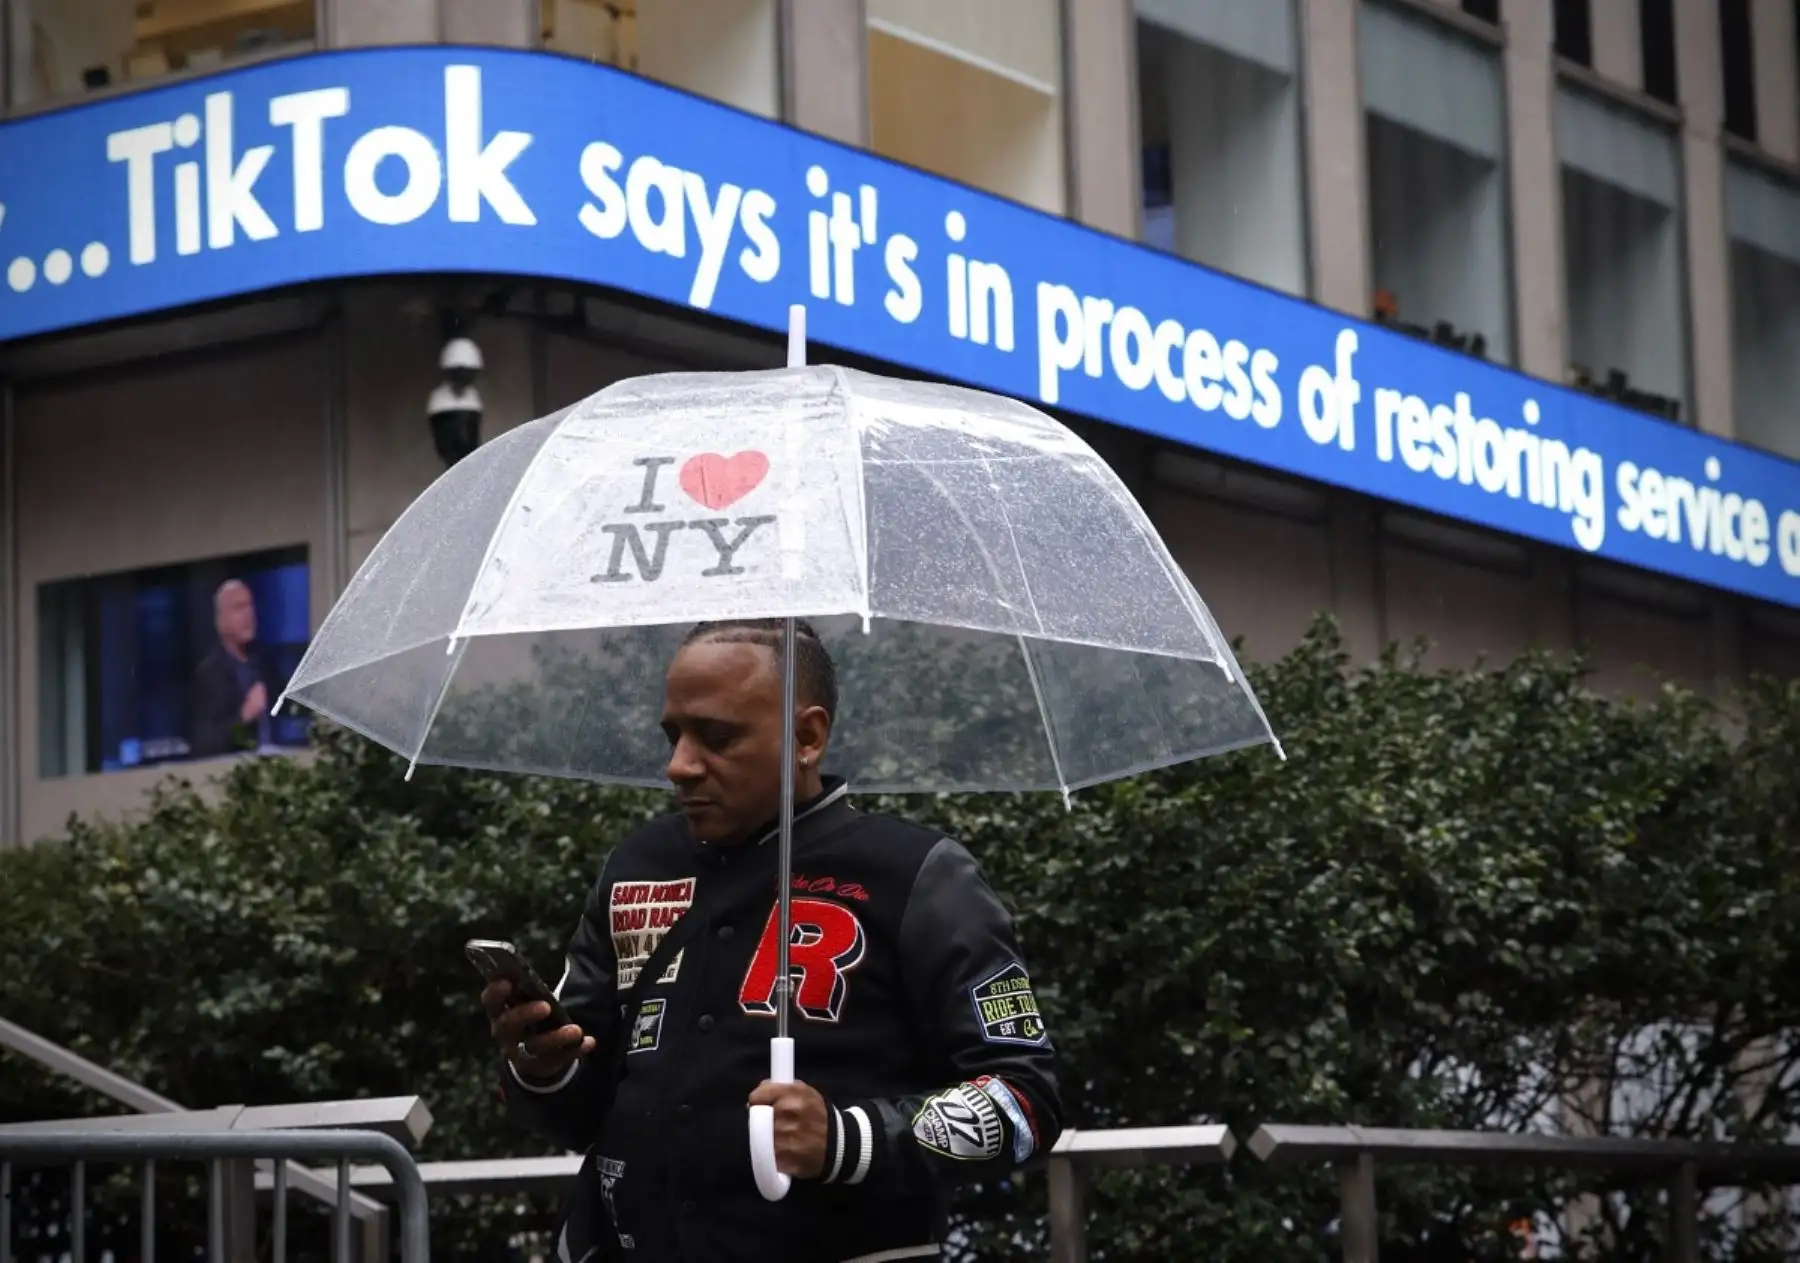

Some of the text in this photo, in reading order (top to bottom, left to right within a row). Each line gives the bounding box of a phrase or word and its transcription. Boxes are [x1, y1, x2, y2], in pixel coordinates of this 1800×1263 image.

[0, 64, 537, 292] ...TikTok
[578, 141, 780, 309] says
[805, 165, 922, 323] it's
[945, 211, 1014, 352] in
[1037, 282, 1282, 429] process
[1298, 328, 1360, 451] of
[1374, 387, 1605, 552] restoring
[1617, 456, 1770, 566] service
[624, 456, 675, 513] I
[590, 514, 777, 582] NY
[612, 885, 649, 905] SANTA
[612, 908, 648, 933] ROAD
[738, 896, 866, 1023] R
[982, 997, 1017, 1022] RIDE
[1000, 1021, 1016, 1036] EST
[924, 1109, 949, 1149] CHAMP
